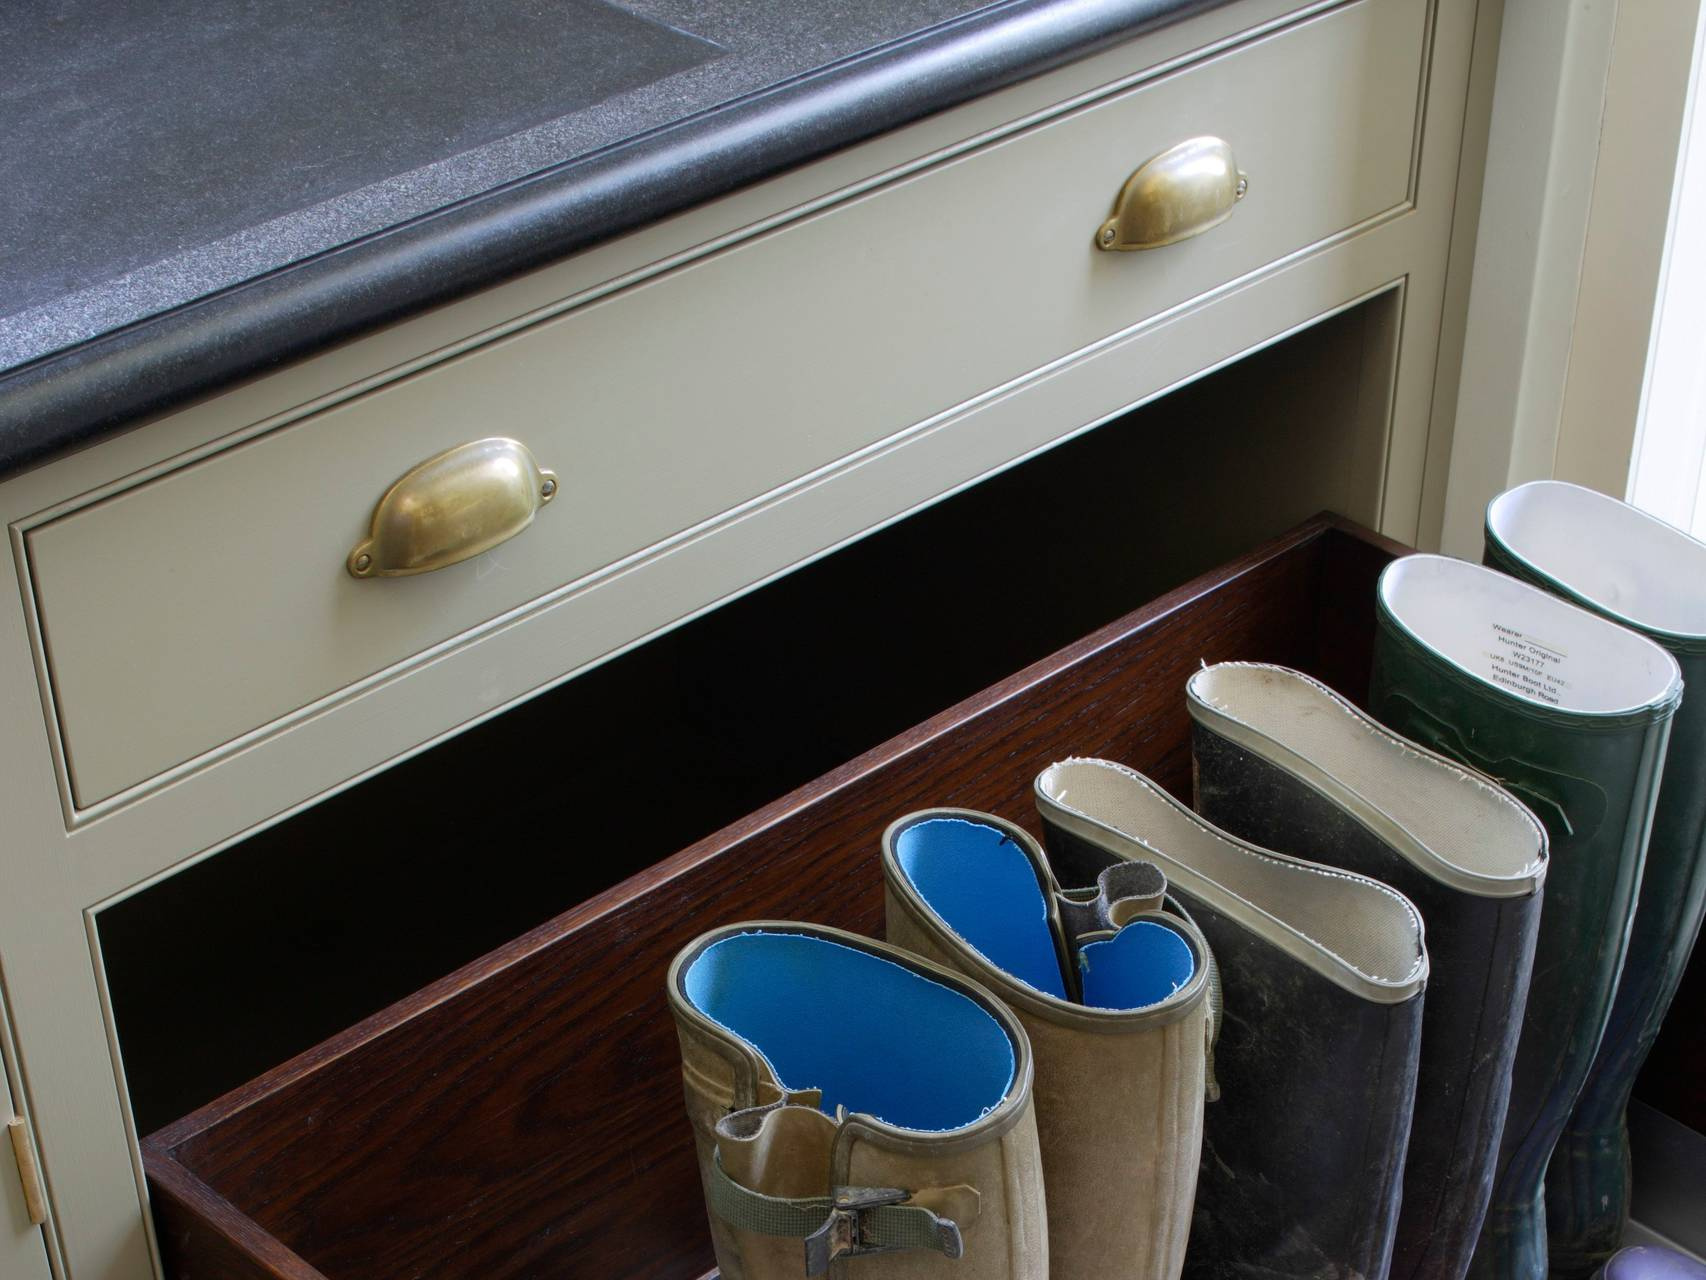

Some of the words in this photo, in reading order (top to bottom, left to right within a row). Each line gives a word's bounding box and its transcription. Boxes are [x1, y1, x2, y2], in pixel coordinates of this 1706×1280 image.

[1493, 624, 1522, 637] Wearer
[1498, 636, 1526, 649] Hunter
[1529, 647, 1560, 663] Original
[1513, 651, 1544, 667] W23177
[1492, 664, 1520, 678] Hunter
[1523, 675, 1541, 687] Boot
[1493, 674, 1536, 695] Edinburgh
[1538, 691, 1558, 704] Road
